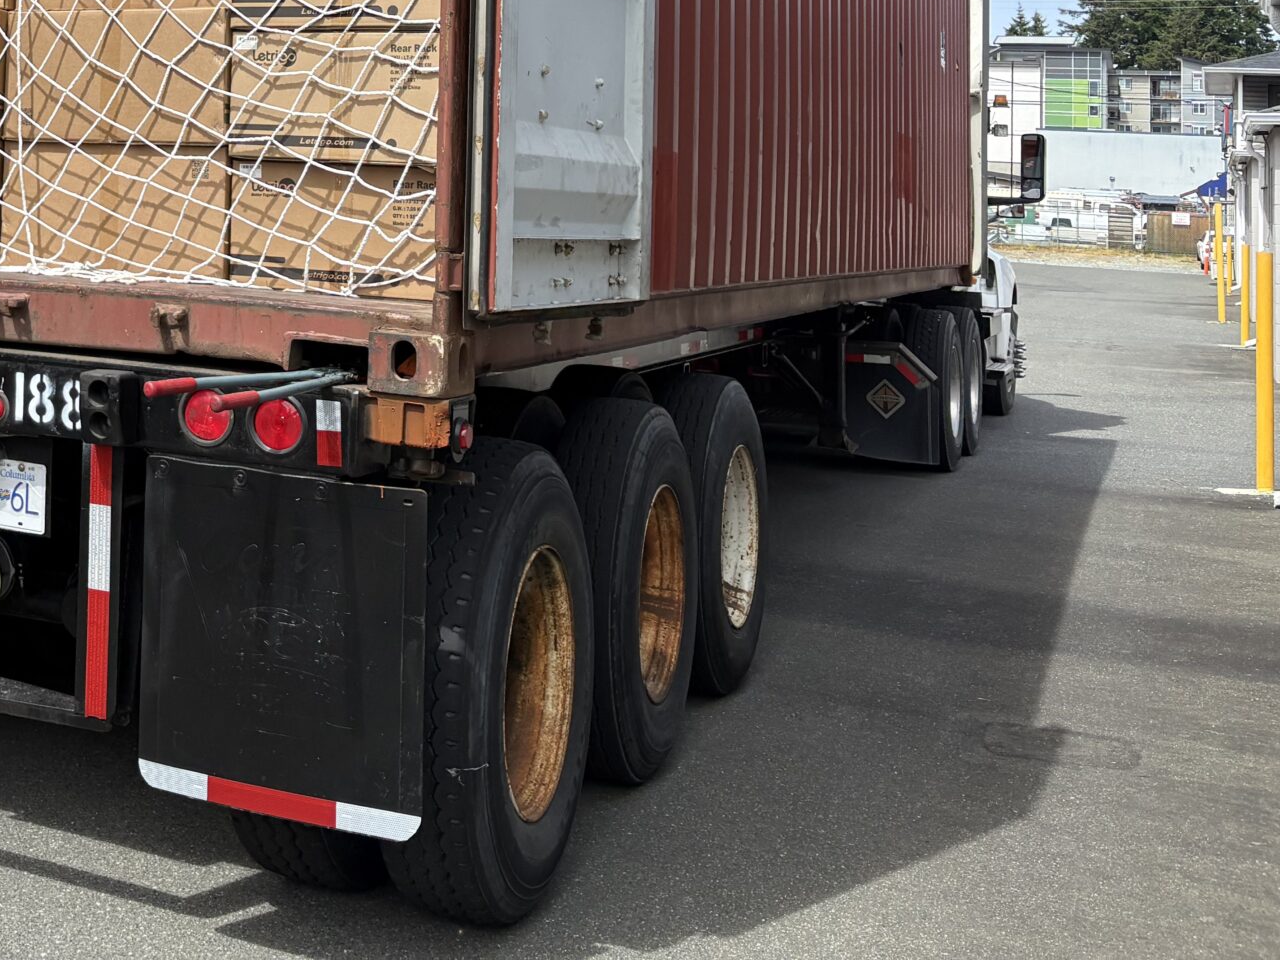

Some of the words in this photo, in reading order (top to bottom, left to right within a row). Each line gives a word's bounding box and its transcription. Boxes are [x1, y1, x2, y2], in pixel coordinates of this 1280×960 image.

[390, 43, 412, 52] Rear
[299, 137, 354, 147] Letgo.com
[393, 180, 415, 189] Rar
[302, 270, 357, 281] etrigo.co
[0, 468, 36, 482] Columbia
[10, 481, 39, 516] 6L
